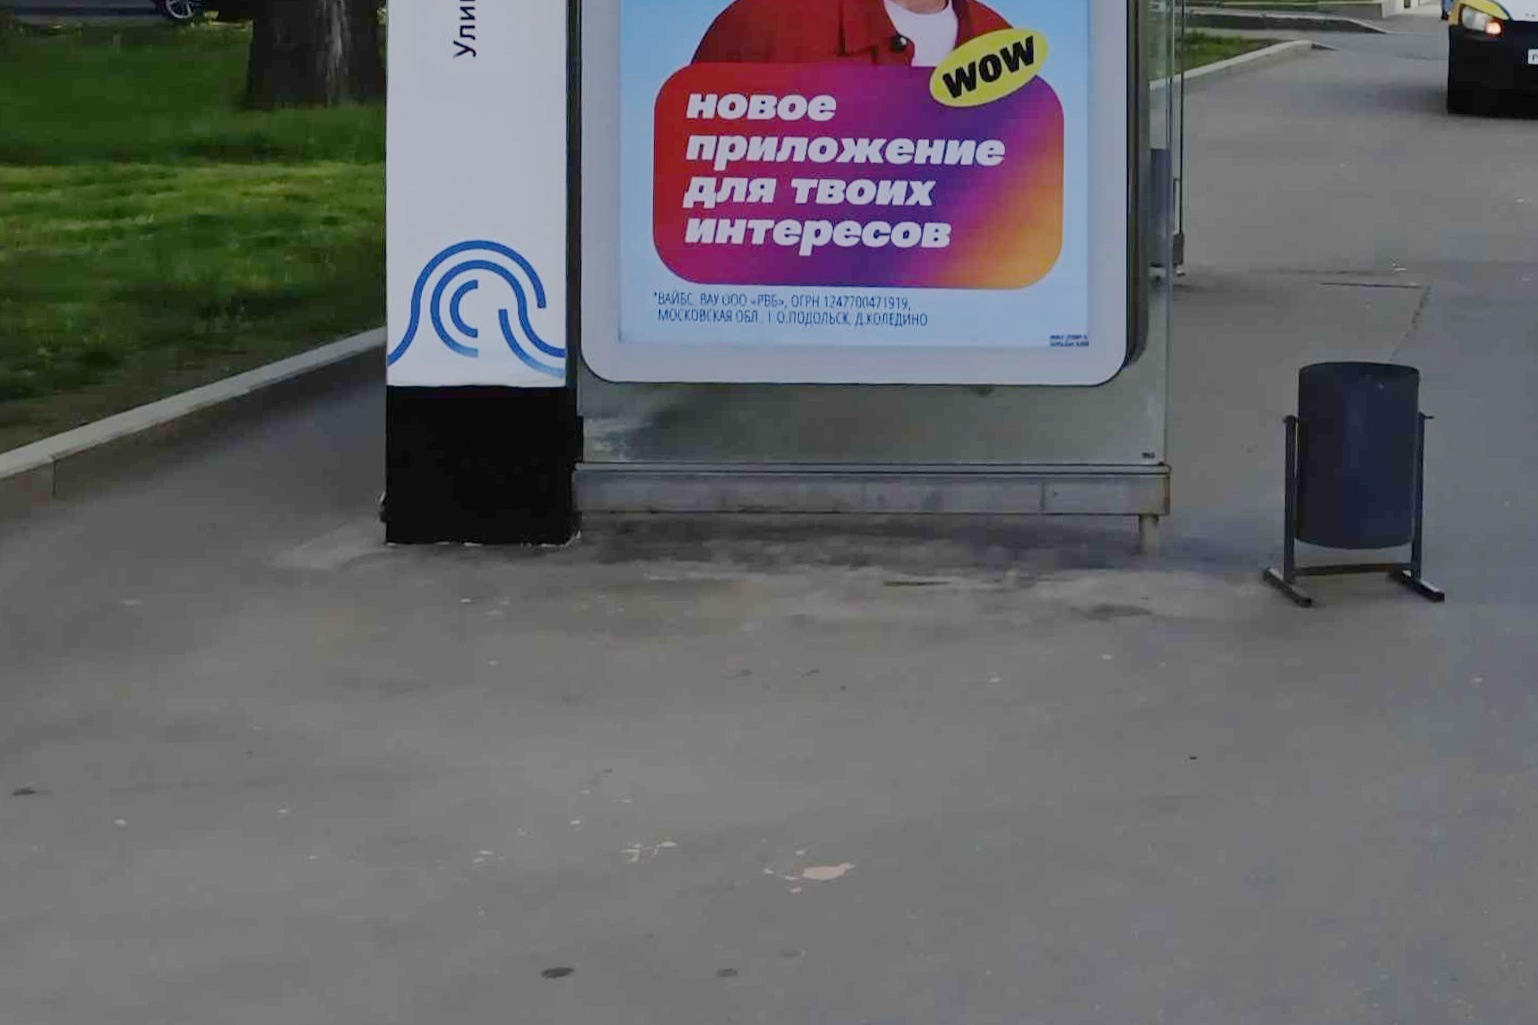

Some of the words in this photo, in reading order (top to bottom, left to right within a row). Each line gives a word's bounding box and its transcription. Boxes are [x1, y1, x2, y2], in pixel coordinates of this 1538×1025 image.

[686, 93, 837, 122] новое
[686, 135, 1005, 171] приложение
[682, 176, 777, 209] для
[791, 178, 936, 206] твоих
[685, 218, 952, 256] интересов
[658, 309, 732, 323] МОСКОВСКАЯ
[791, 294, 820, 308] ОГРН
